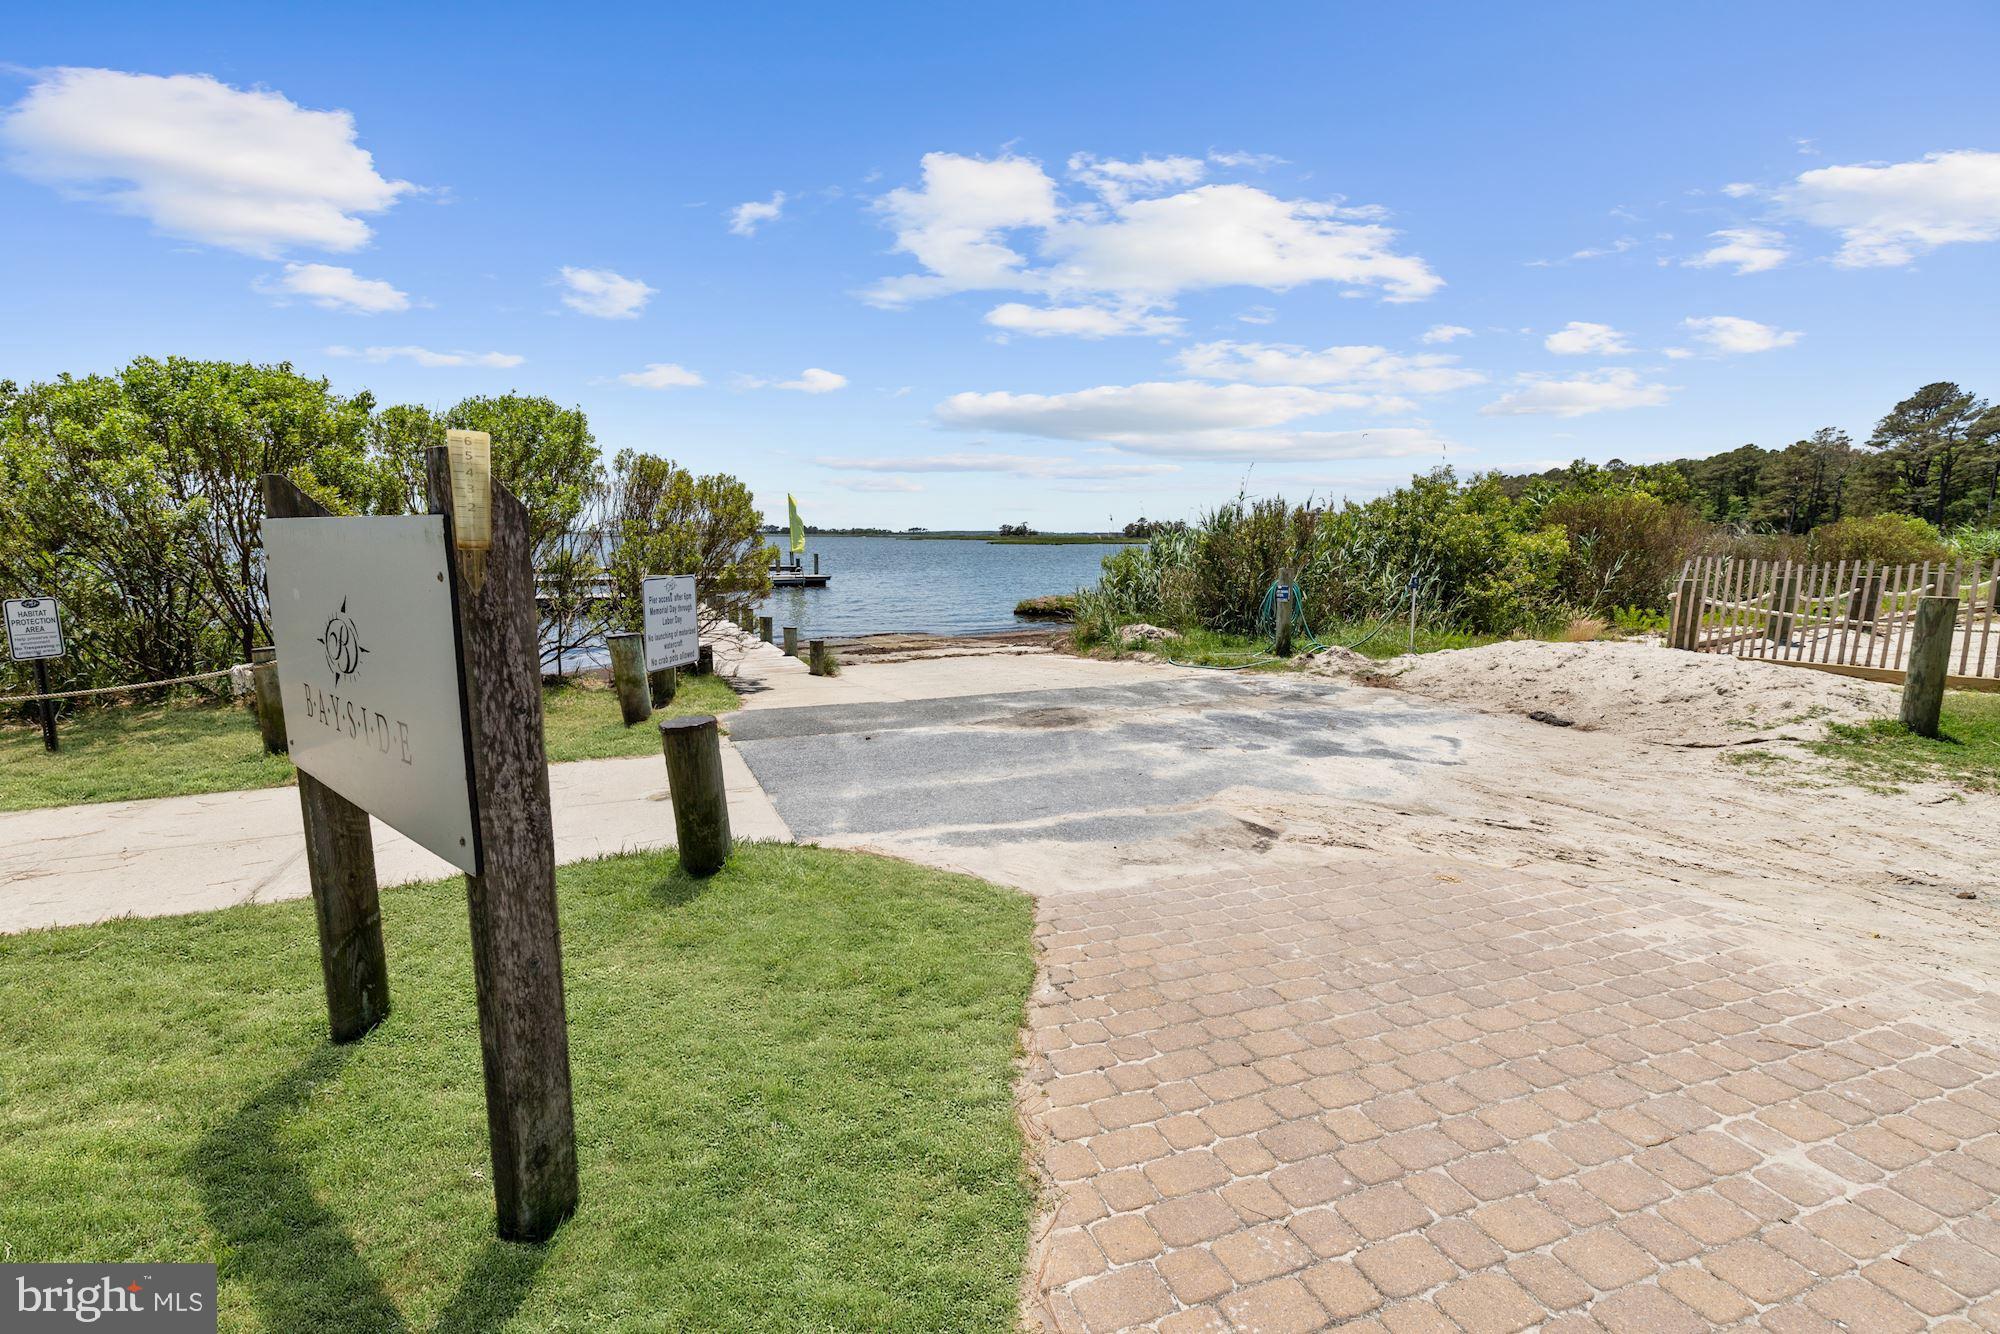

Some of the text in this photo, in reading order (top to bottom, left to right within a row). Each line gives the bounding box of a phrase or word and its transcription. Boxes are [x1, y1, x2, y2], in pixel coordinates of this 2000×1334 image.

[464, 436, 472, 446] 6
[465, 450, 472, 460] 5
[466, 468, 473, 477] 4
[467, 484, 474, 494] 3
[468, 502, 476, 512] 2
[648, 596, 657, 604] Pier
[658, 594, 672, 603] access
[650, 606, 668, 616] Memorial
[677, 604, 693, 613] through
[11, 617, 56, 626] PROTECTION
[662, 616, 674, 626] Labor
[655, 632, 673, 641] launching
[679, 628, 696, 636] motorized
[664, 640, 683, 650] watercraft
[651, 650, 695, 666] No crab pots allowed
